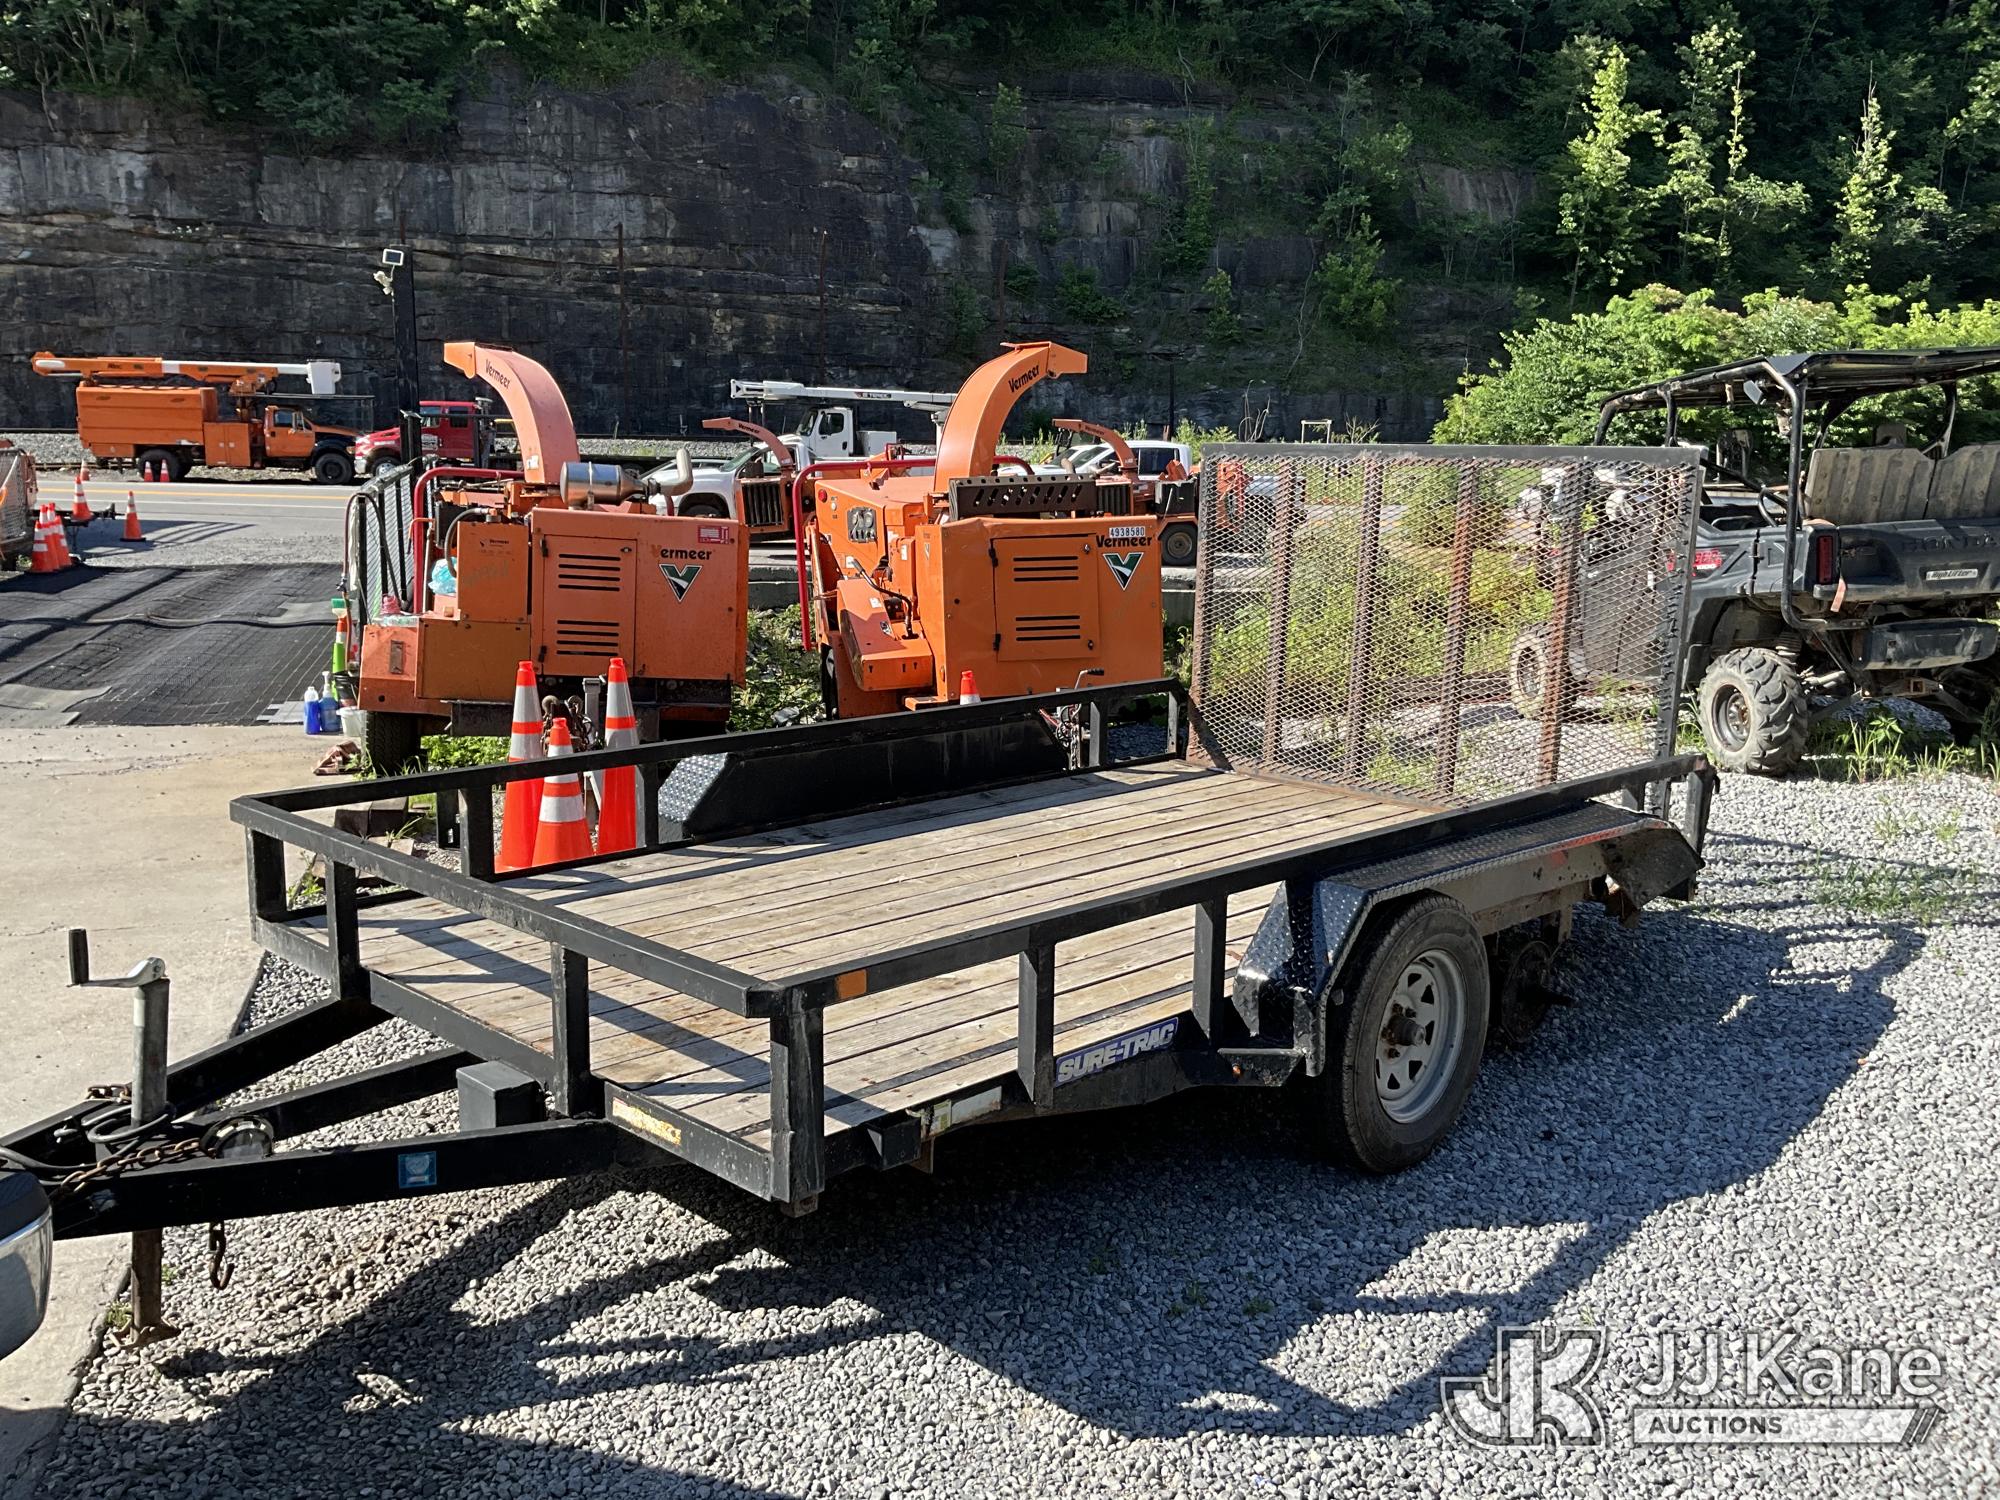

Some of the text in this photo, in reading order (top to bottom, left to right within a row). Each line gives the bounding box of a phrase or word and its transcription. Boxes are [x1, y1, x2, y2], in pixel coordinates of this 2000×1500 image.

[485, 359, 511, 389] Vermeer
[1008, 364, 1039, 393] Vermeer
[1095, 535, 1153, 548] Vermeer
[1110, 526, 1145, 537] 4938580
[1057, 1022, 1175, 1083] SURE-TRAC
